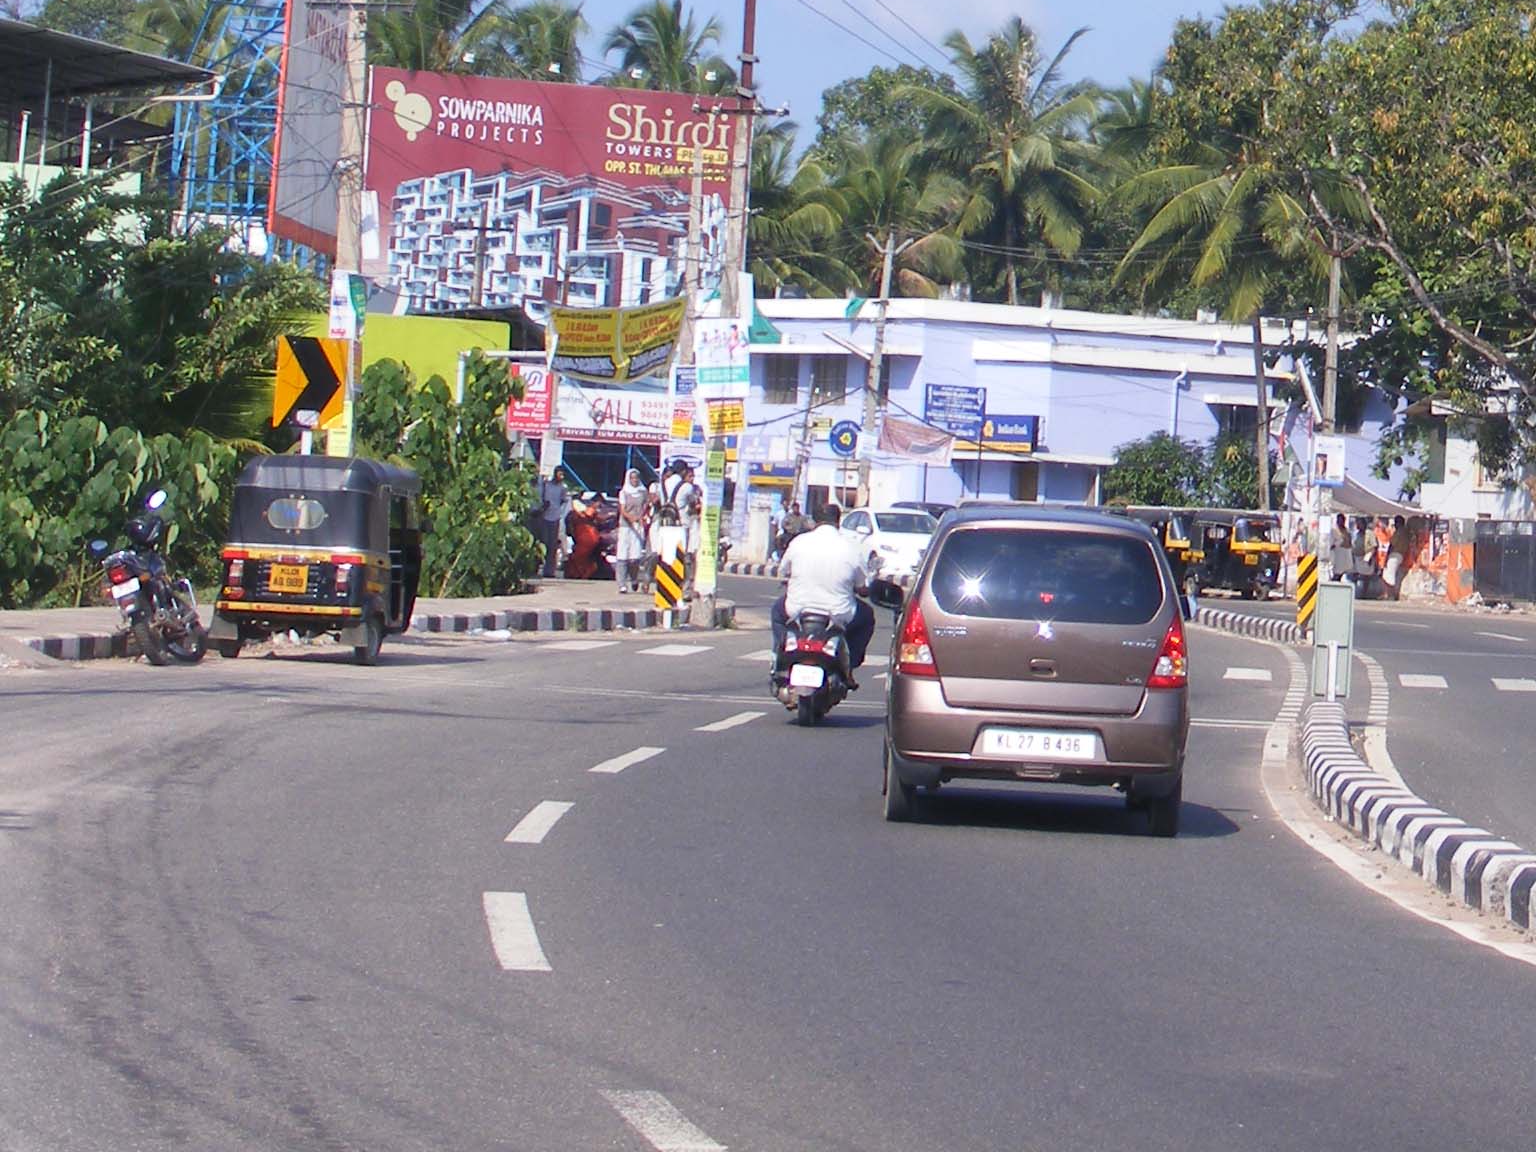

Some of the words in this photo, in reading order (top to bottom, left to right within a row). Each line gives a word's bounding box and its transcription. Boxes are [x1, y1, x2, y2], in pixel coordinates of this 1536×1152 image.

[438, 95, 544, 126] SOWPARNIKA
[436, 121, 543, 145] PROJECTS
[606, 103, 731, 150] Shirdi
[604, 142, 673, 159] TOWERS
[604, 160, 626, 173] OPP.
[628, 161, 642, 175] ST.
[591, 397, 636, 429] CALL
[996, 733, 1012, 747] KL
[1018, 735, 1034, 749] 27
[1055, 738, 1081, 753] 436
